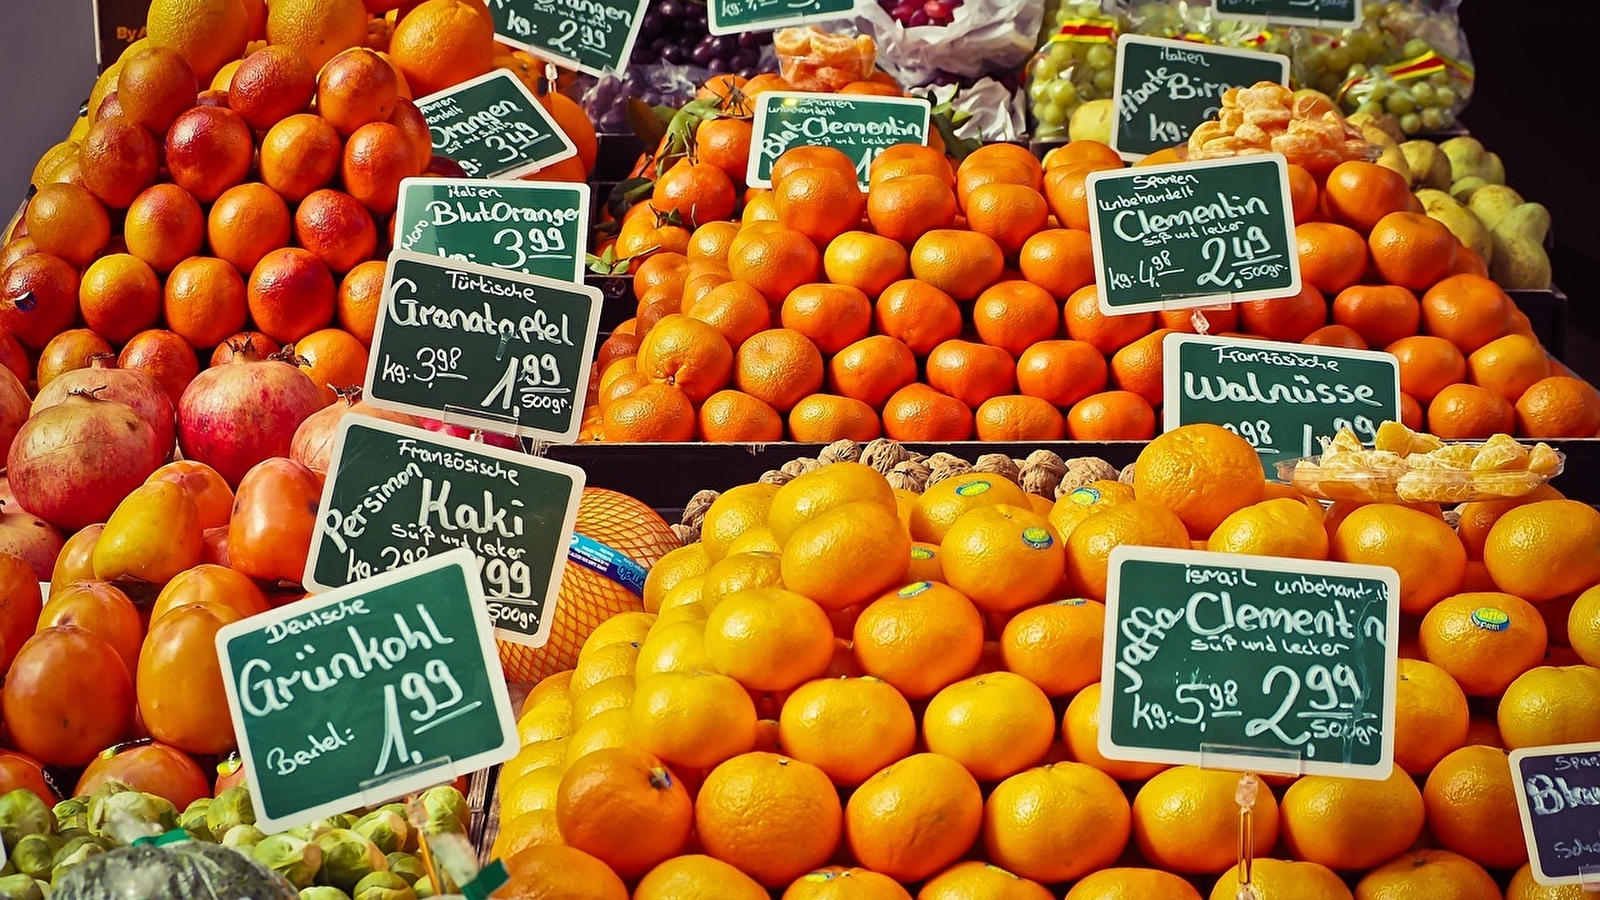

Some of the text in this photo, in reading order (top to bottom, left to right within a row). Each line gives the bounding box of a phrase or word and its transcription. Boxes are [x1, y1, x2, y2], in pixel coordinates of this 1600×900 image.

[506, 9, 538, 37] kg:
[429, 99, 524, 149] Orangen
[801, 116, 923, 138] Clementin
[1149, 112, 1189, 143] kg:
[1133, 173, 1200, 190] Spanien
[1113, 192, 1270, 243] Clementin
[446, 270, 538, 305] Türkische
[1108, 266, 1137, 291] kg:
[388, 277, 575, 347] Granatapfel
[382, 353, 411, 385] kg:
[1212, 346, 1340, 373] Französische
[1184, 371, 1384, 408] Walnüsse
[397, 439, 520, 487] Französische
[323, 461, 525, 554] Persimon Kaki
[265, 599, 370, 644] Deutsche
[239, 603, 454, 717] Grünkohl
[1241, 636, 1277, 653] und
